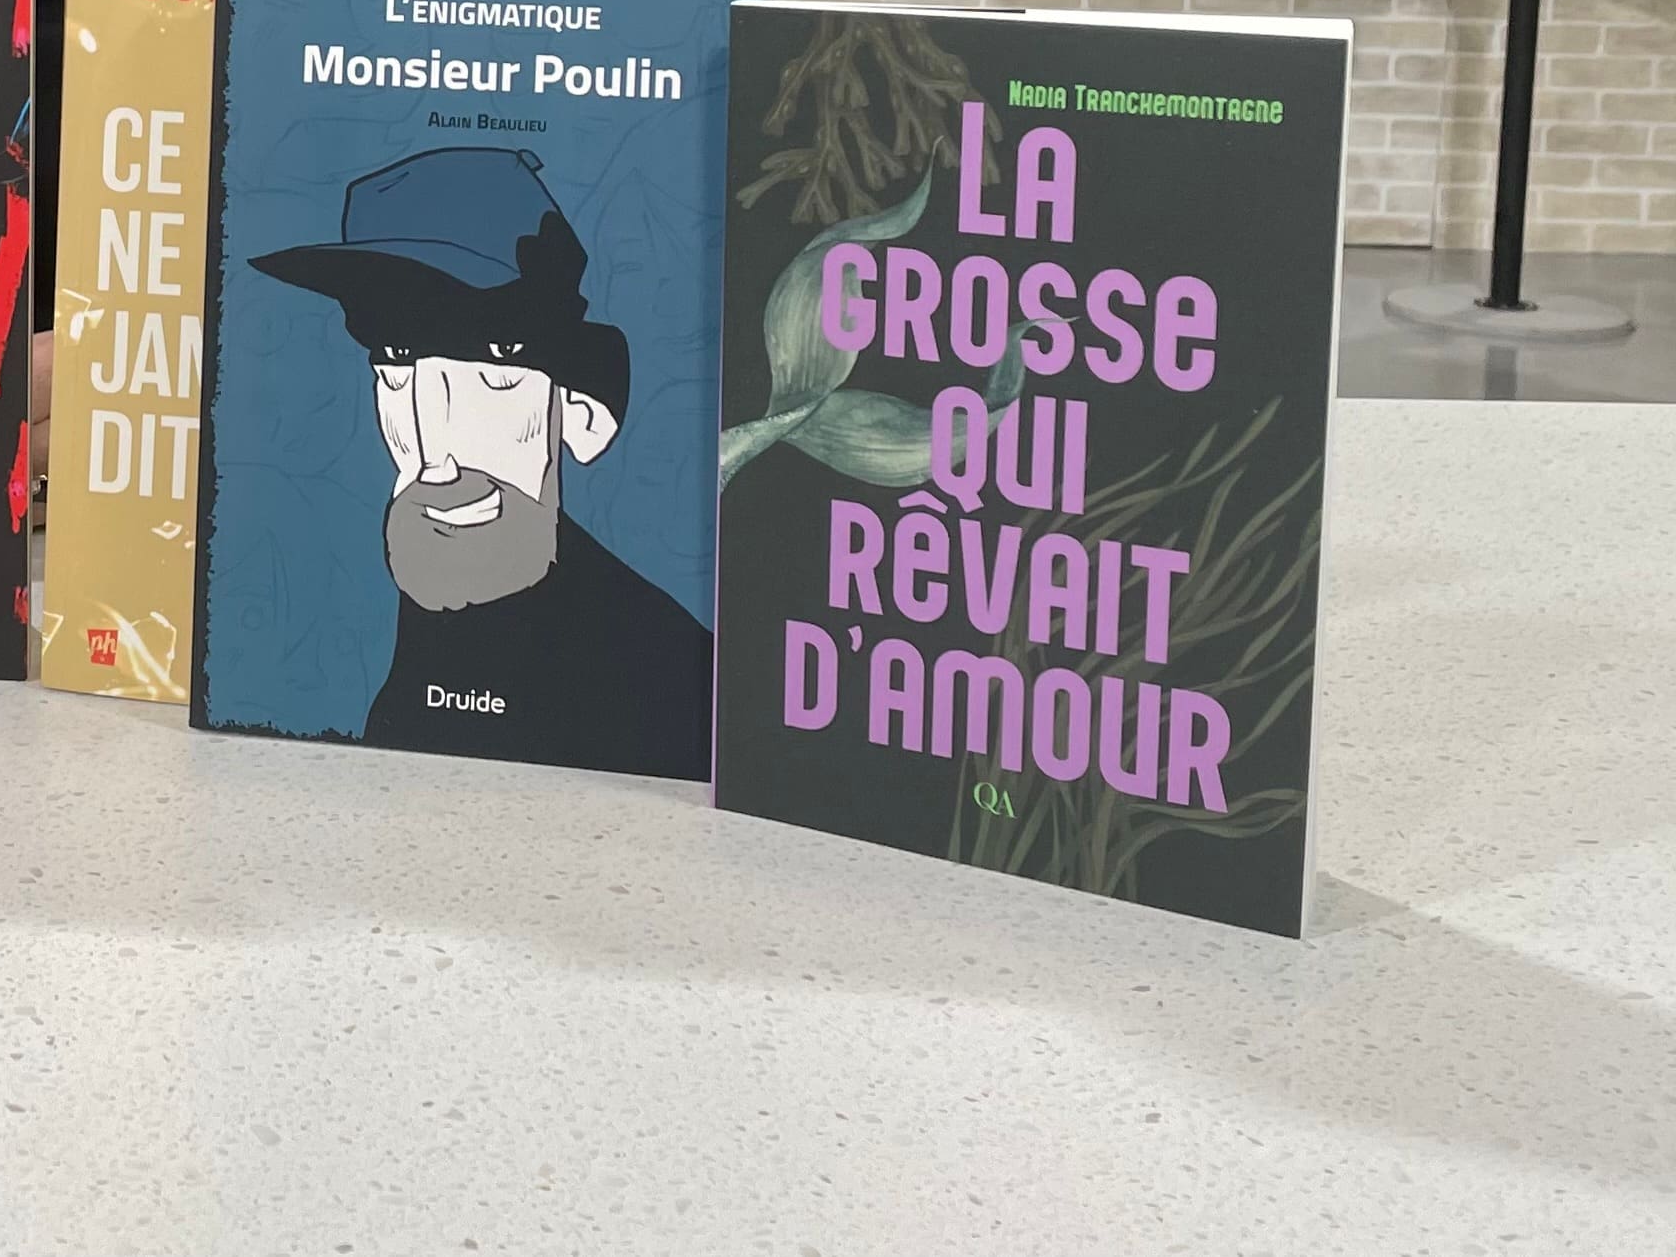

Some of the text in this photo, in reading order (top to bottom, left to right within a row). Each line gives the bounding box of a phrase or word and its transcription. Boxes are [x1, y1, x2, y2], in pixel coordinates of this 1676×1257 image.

[303, 45, 682, 100] Monsieur Poulin
[102, 106, 184, 194] CE
[958, 102, 1077, 243] LA
[97, 208, 184, 296] NE
[89, 409, 200, 500] DIT
[931, 386, 1088, 514] QUI
[427, 685, 506, 714] Druide
[973, 782, 1017, 818] QA
